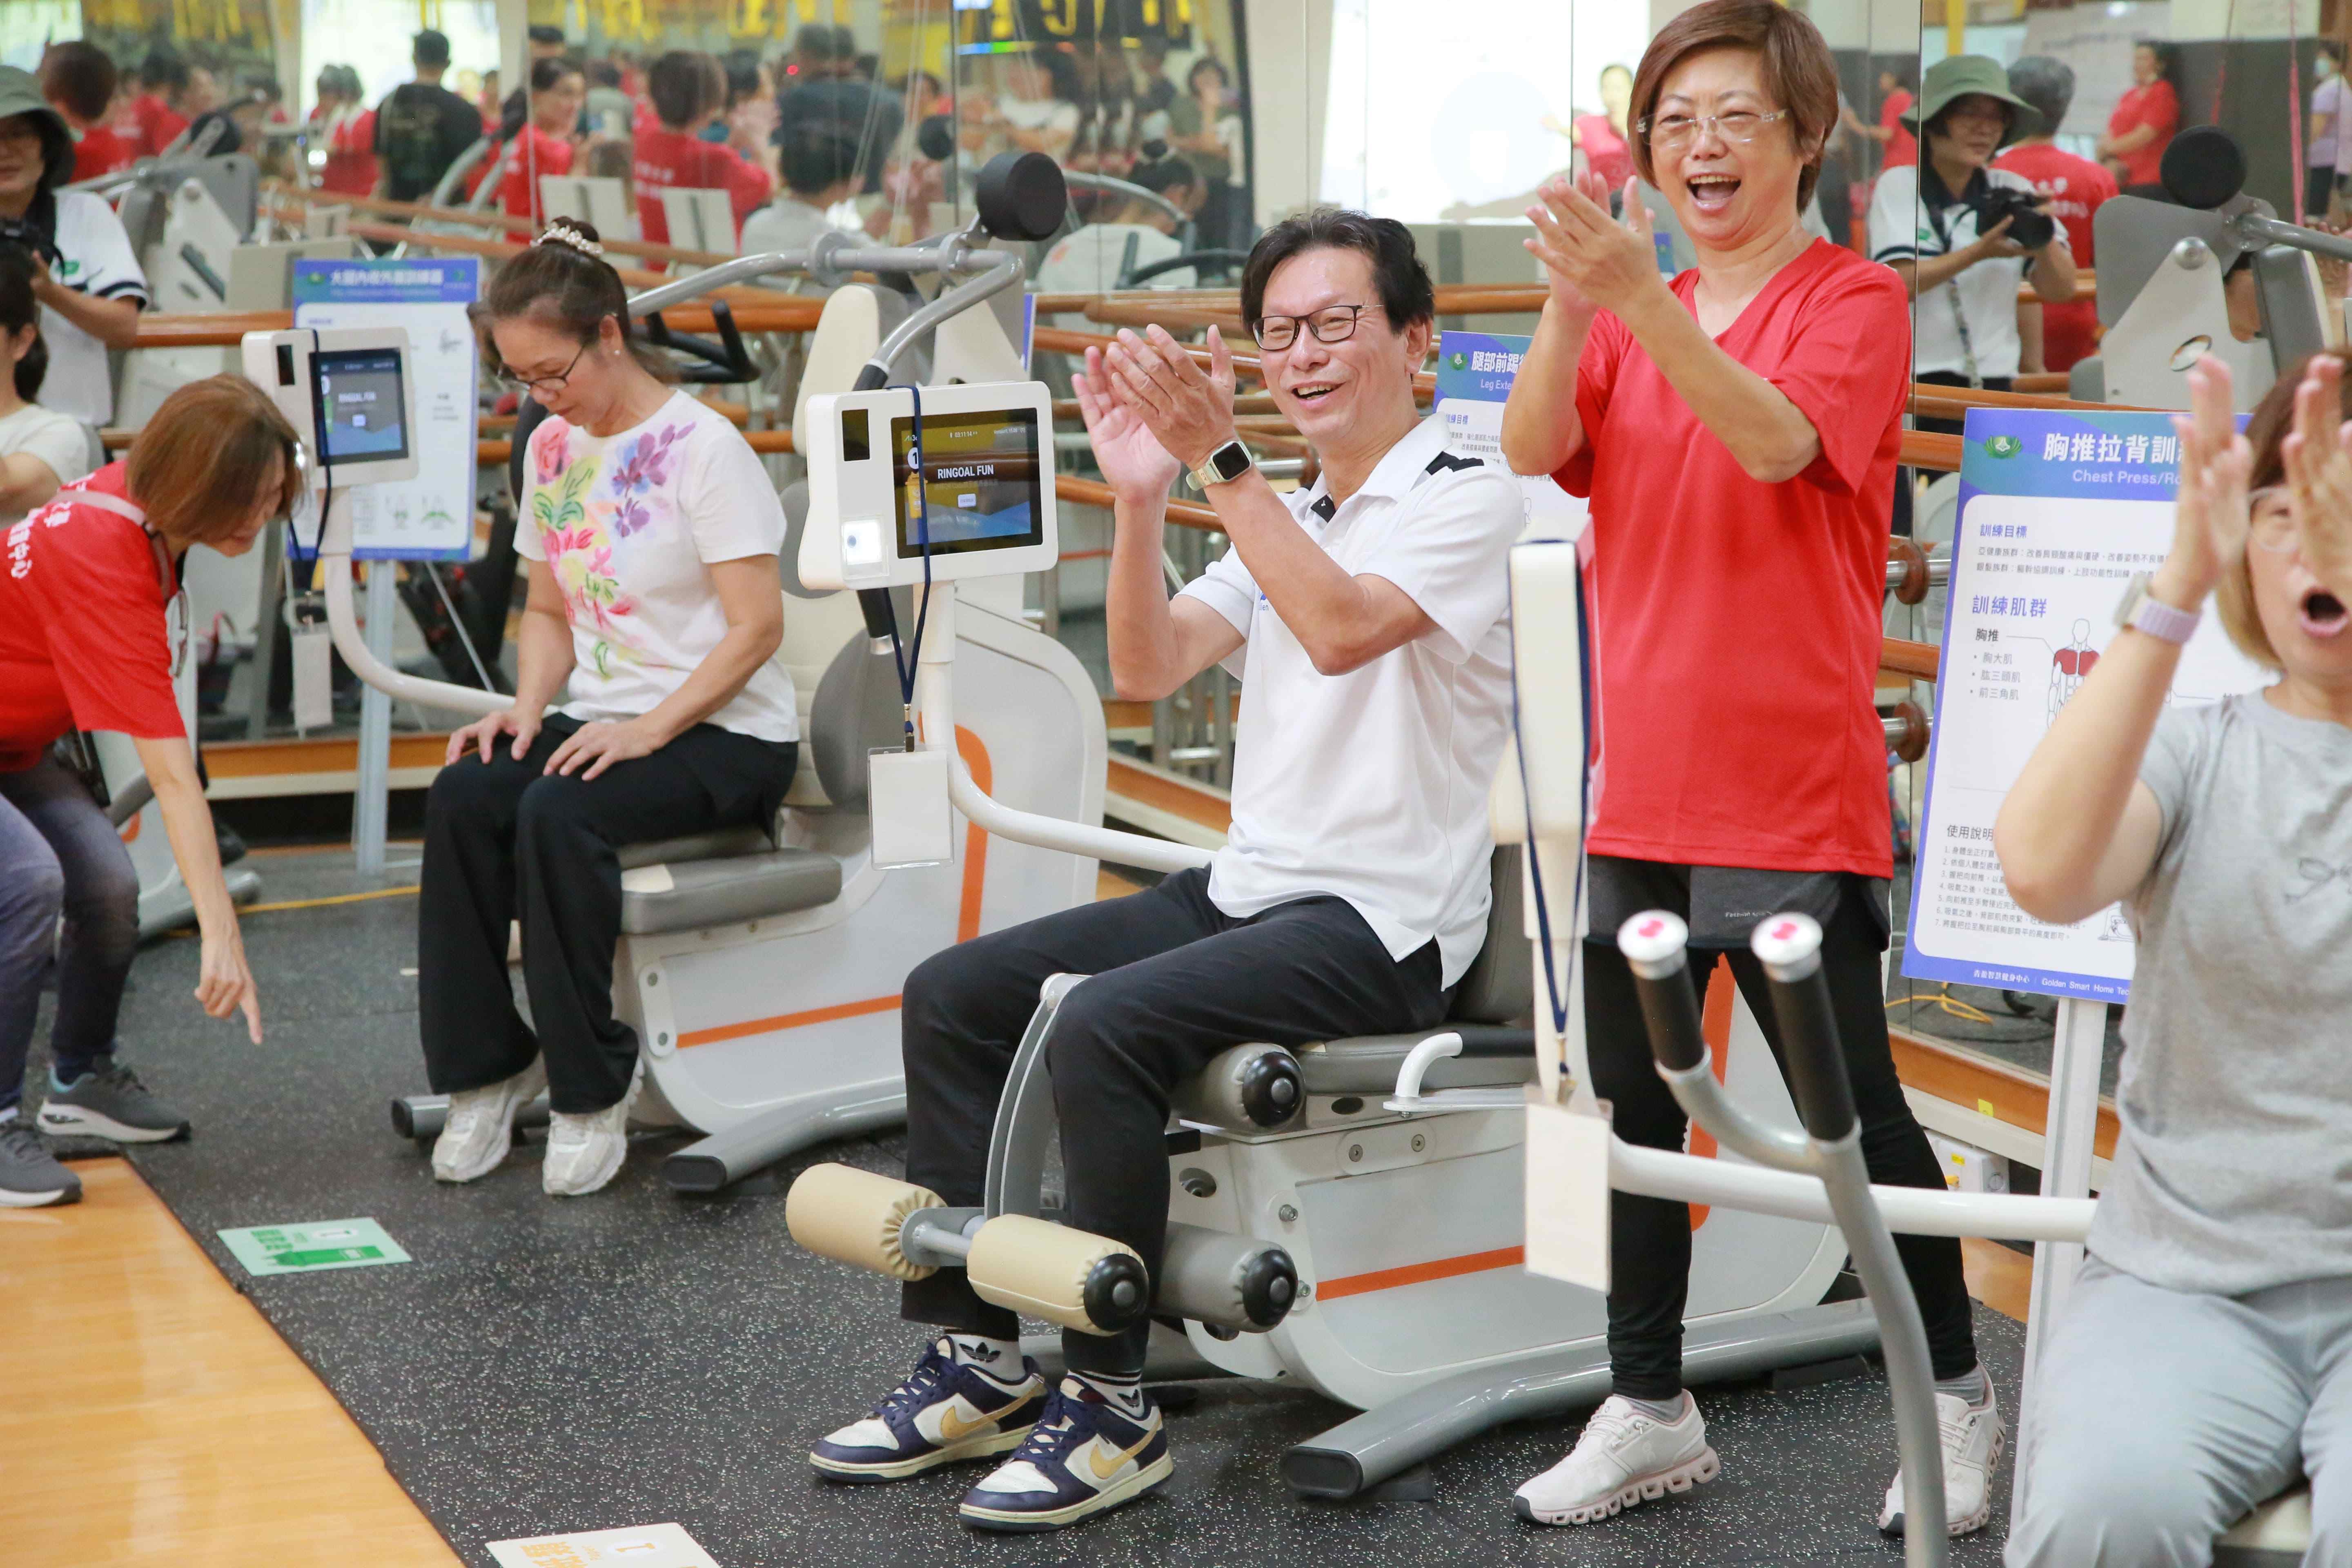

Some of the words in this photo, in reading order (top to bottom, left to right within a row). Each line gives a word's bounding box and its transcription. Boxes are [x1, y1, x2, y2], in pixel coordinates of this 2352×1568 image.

[1481, 379, 1494, 391] Leg
[2043, 433, 2185, 464] 胸推拉背訓
[938, 466, 975, 479] RINGOAL
[977, 465, 994, 475] FUN
[2073, 469, 2113, 483] Chest
[1980, 523, 2027, 538] 訓練目標
[1972, 595, 2047, 617] 訓練肌群
[1976, 628, 1999, 642] 胸推
[1983, 652, 2012, 664] 胸大肌
[1980, 687, 2019, 701] 前三角肌
[1947, 824, 1993, 841] 使用說明
[2042, 978, 2066, 988] Golden
[2069, 981, 2090, 991] Smart
[2094, 984, 2114, 994] Home
